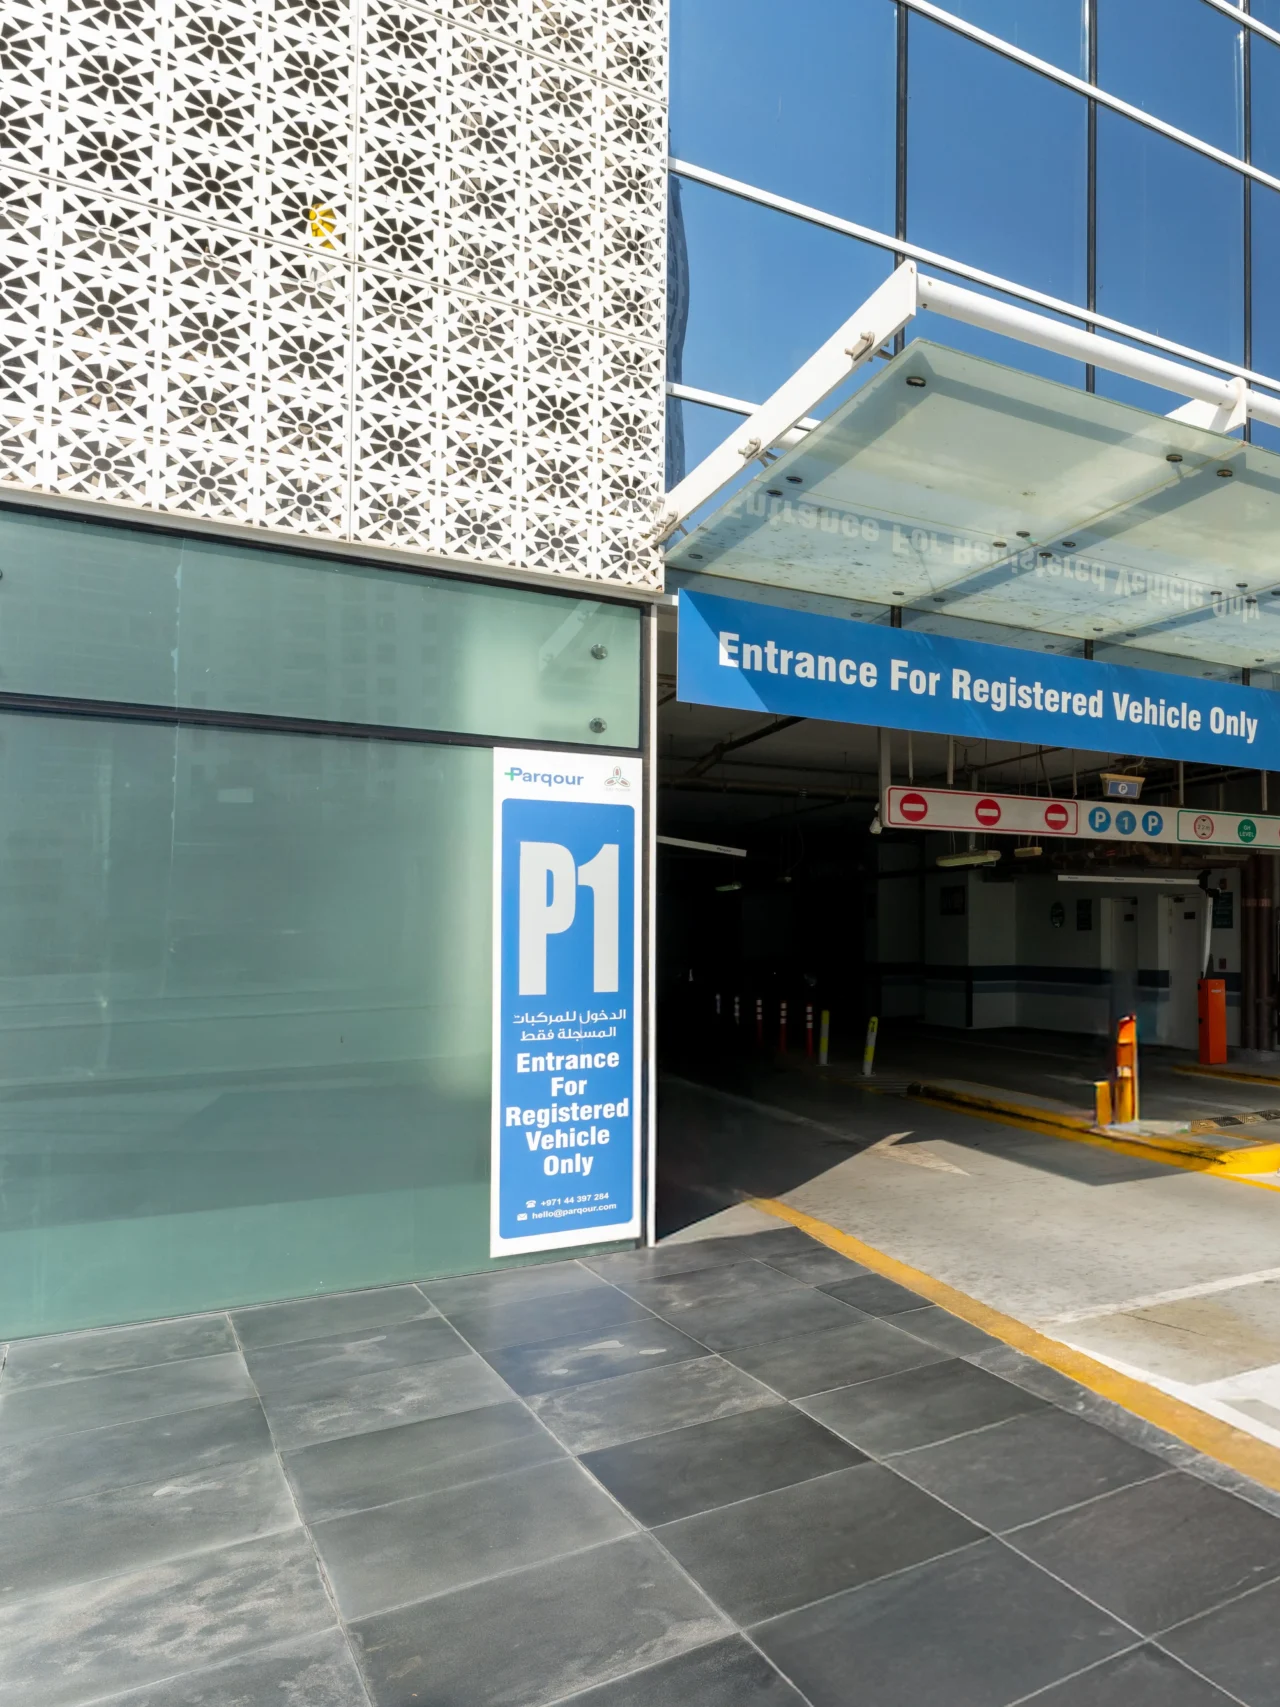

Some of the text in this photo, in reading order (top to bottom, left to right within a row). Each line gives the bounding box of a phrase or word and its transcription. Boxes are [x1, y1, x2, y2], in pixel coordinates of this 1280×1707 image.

[718, 630, 1259, 745] Entrance For Registered Vehicle Only
[505, 766, 584, 787] Parqour
[1094, 811, 1159, 832] P 1 P
[518, 841, 619, 996] P1
[512, 1009, 627, 1026] الدخول للمركبات
[520, 1026, 617, 1042] المسجلة فقط
[516, 1051, 620, 1073] Entrance
[551, 1076, 588, 1097] For
[505, 1097, 629, 1129] Registered
[525, 1126, 610, 1151] Vehicle
[543, 1153, 594, 1177] Only
[540, 1198, 561, 1207] +971
[576, 1194, 592, 1203] 397
[594, 1192, 609, 1200] 284
[532, 1203, 617, 1220] hello@parqour.com
